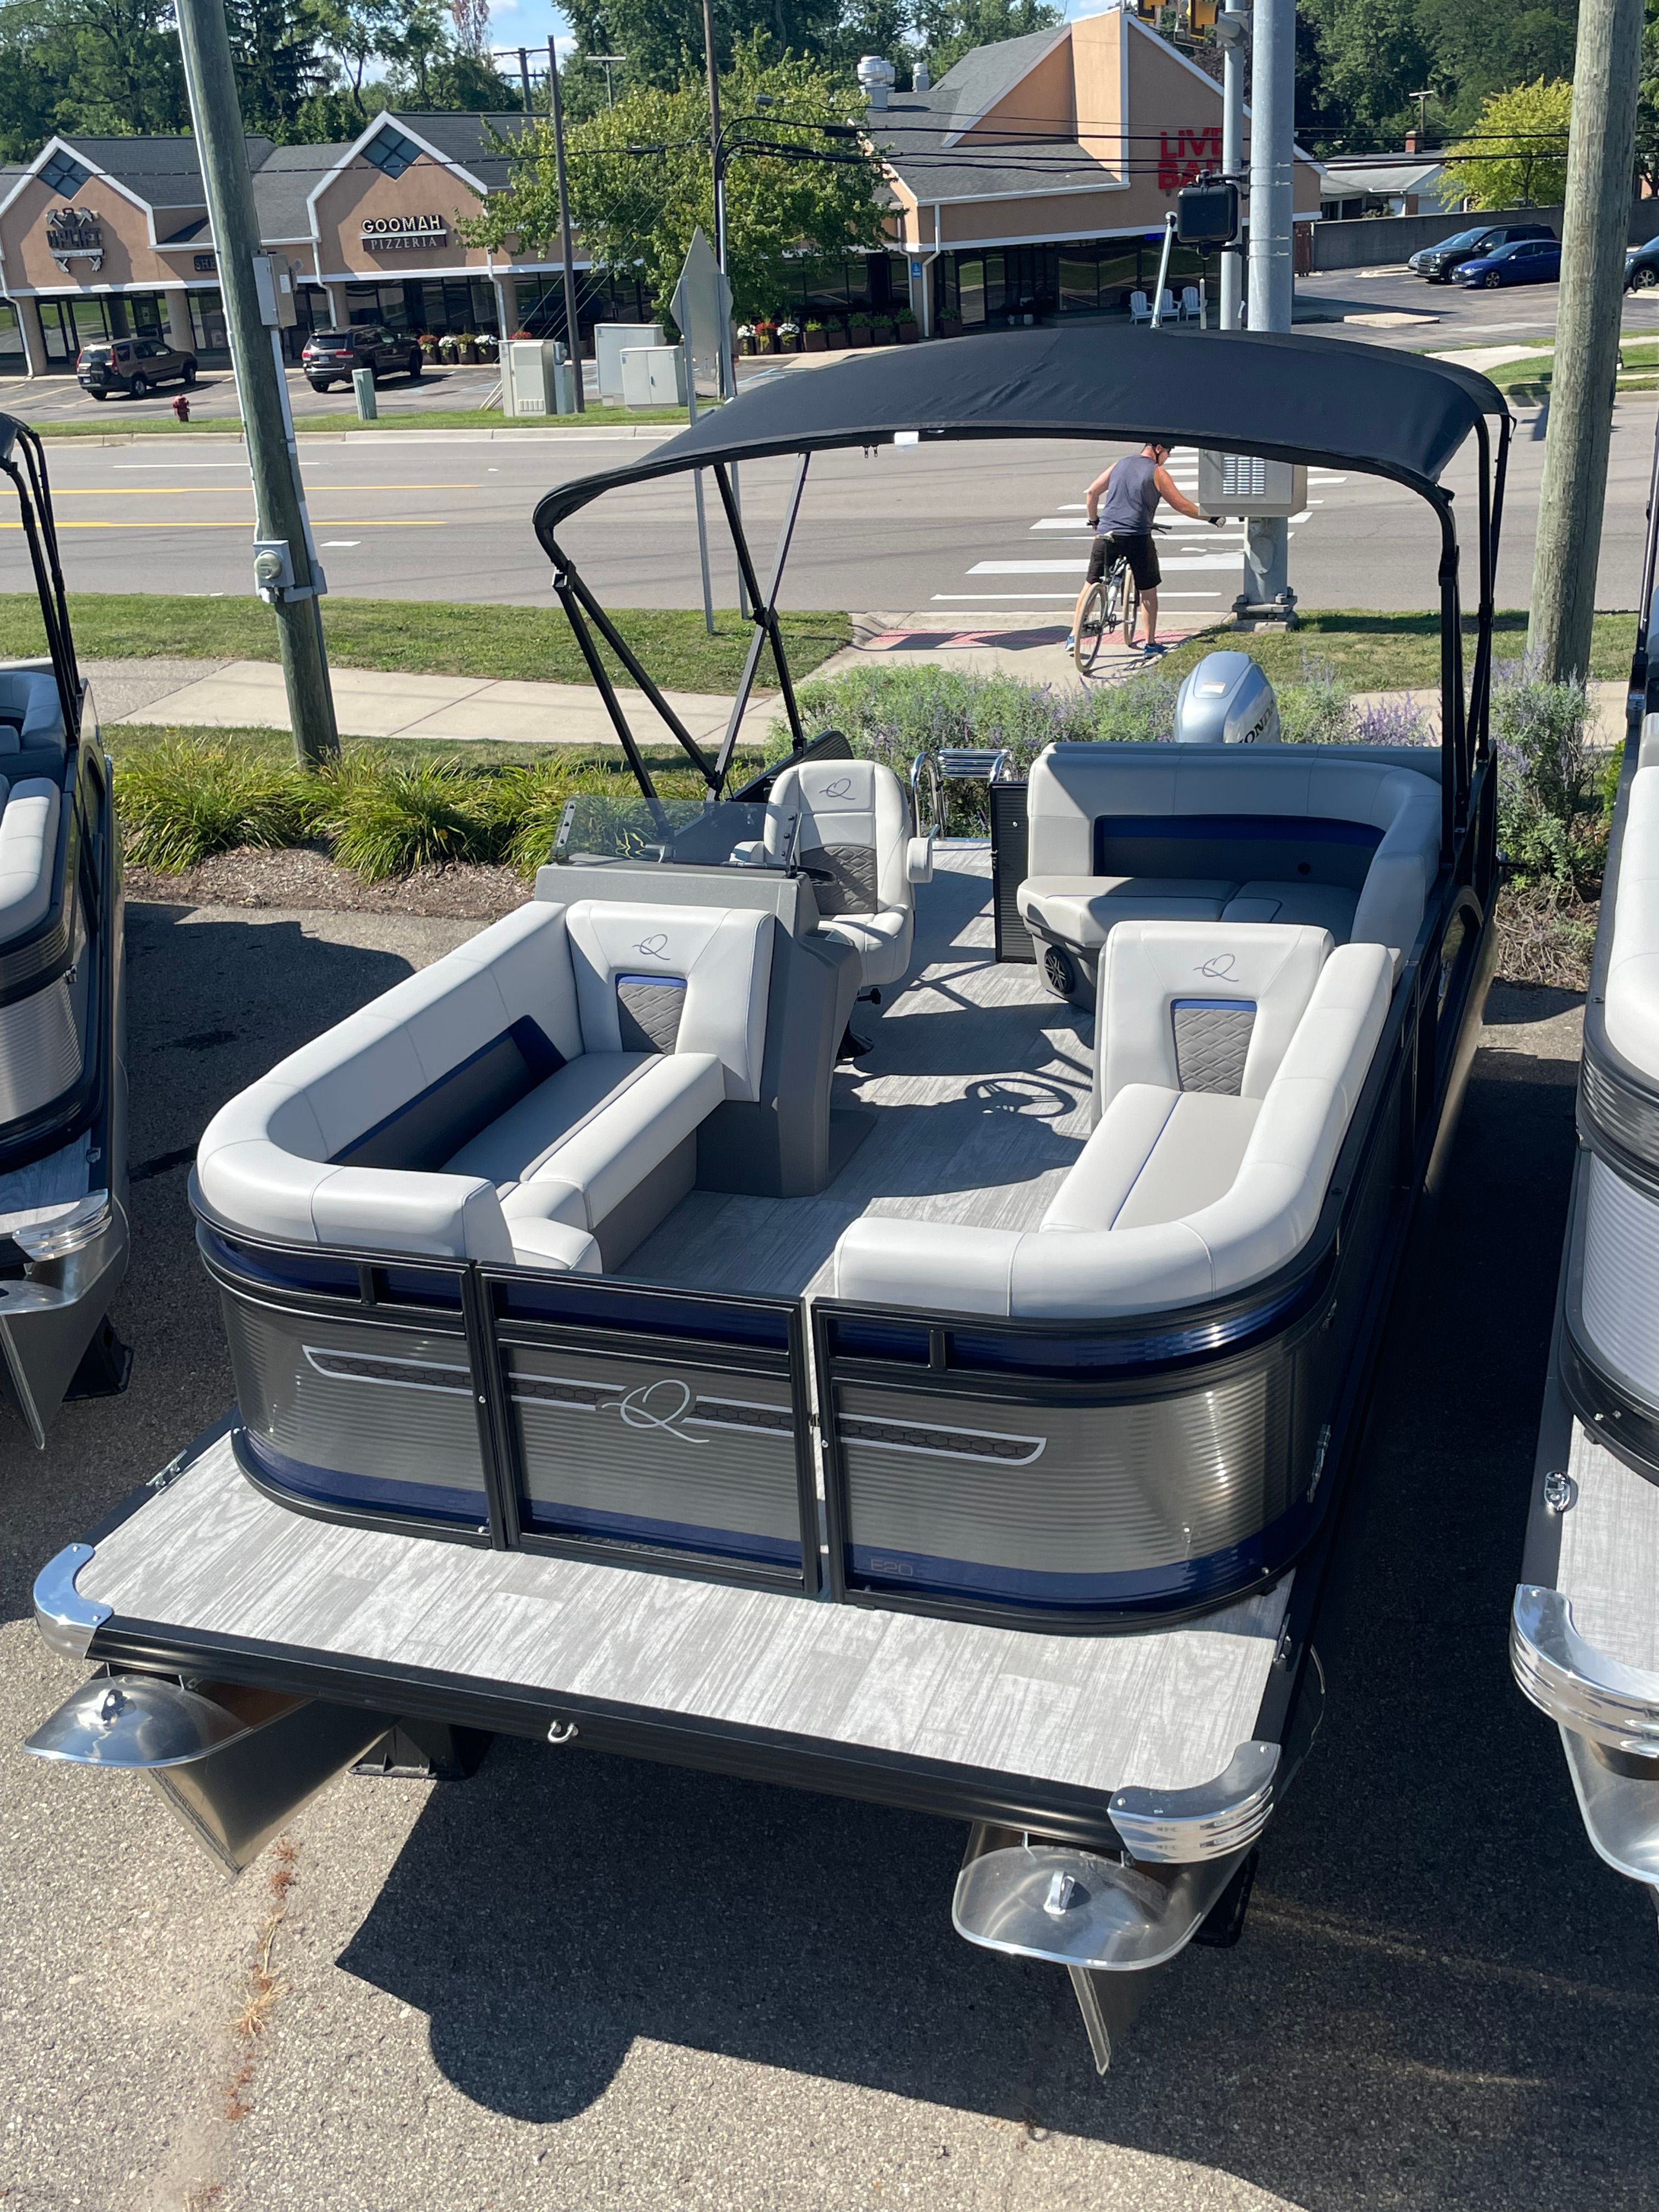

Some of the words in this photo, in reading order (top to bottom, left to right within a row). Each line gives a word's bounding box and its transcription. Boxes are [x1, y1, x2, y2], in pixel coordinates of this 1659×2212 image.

[1160, 127, 1223, 159] LIVE
[362, 214, 441, 233] GOOMAH
[370, 236, 437, 250] PIZZERIA
[1238, 699, 1275, 743] ONDA
